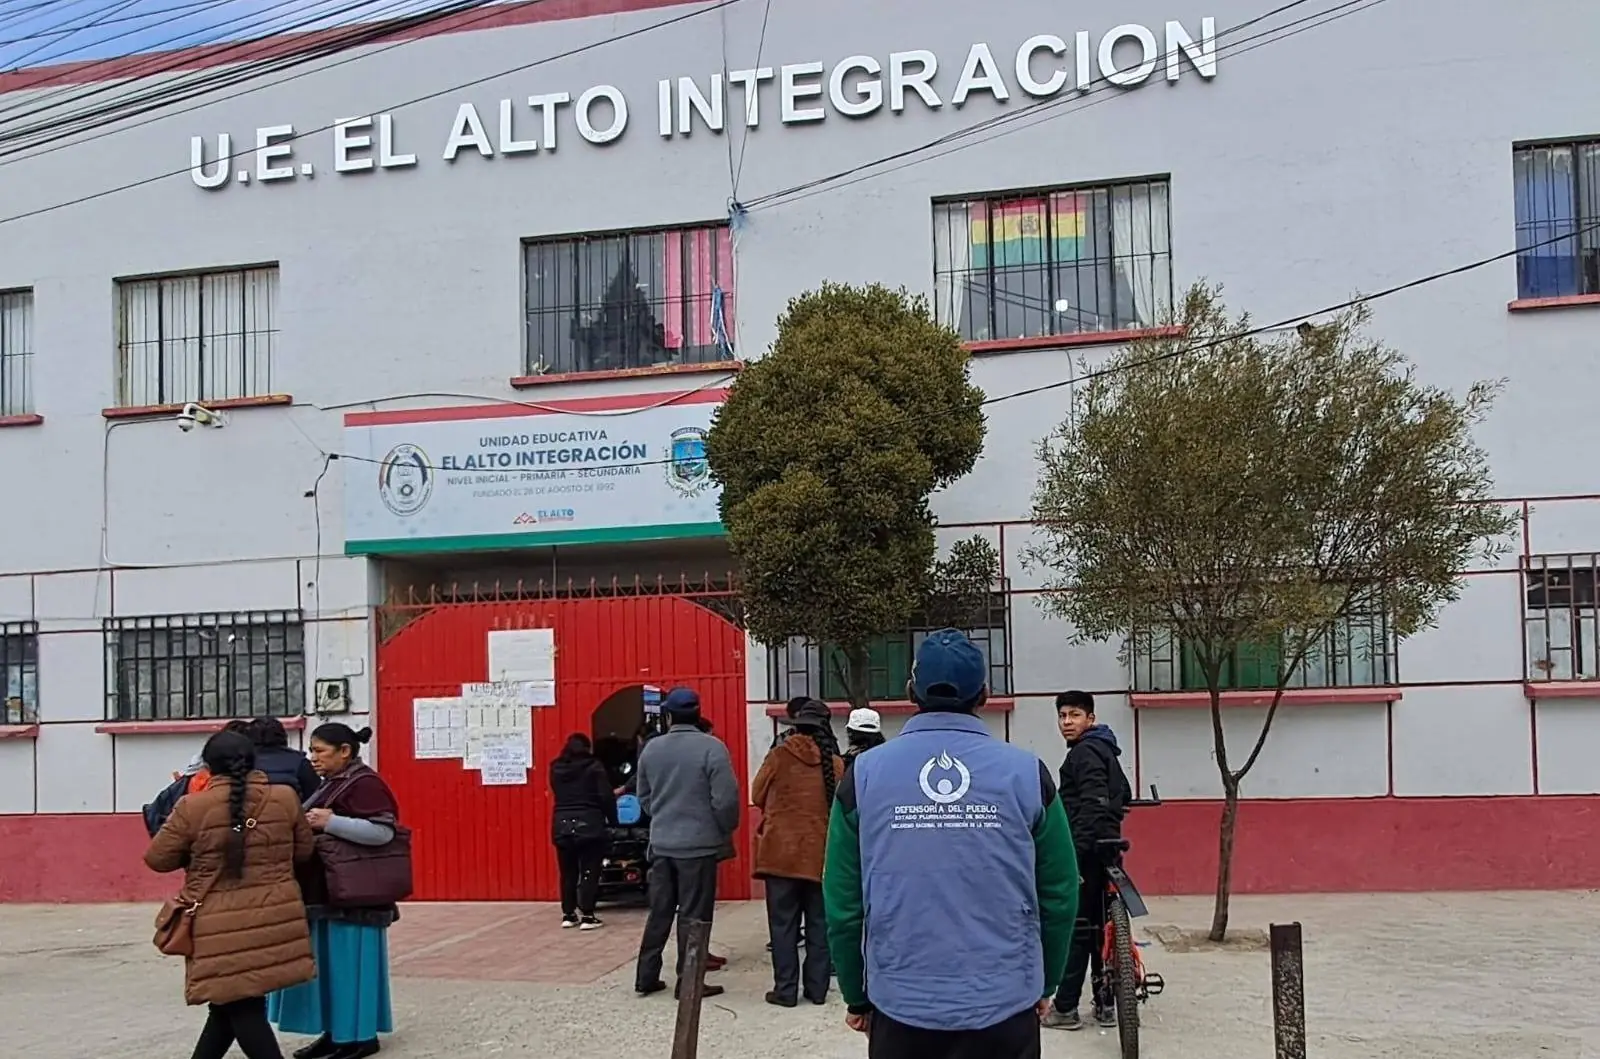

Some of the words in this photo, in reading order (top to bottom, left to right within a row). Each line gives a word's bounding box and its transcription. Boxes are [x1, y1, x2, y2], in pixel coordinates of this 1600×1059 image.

[190, 124, 313, 190] U.E.
[333, 114, 418, 173] EL
[442, 85, 629, 160] ALTO
[657, 17, 1218, 137] INTEGRACION
[479, 434, 530, 448] UNIDAD
[532, 430, 608, 445] EDUCATIVA
[442, 455, 461, 470] EL
[464, 452, 512, 469] ALTO
[515, 440, 647, 467] INTEGRACIÓN
[447, 475, 473, 486] NIVEL
[475, 474, 509, 484] INICIAL
[520, 471, 566, 482] PRIMARIA
[577, 466, 641, 478] SECUNDARIA
[894, 802, 945, 814] DEFENSORÍA
[947, 804, 963, 813] DEL
[965, 804, 997, 814] PUEBLO
